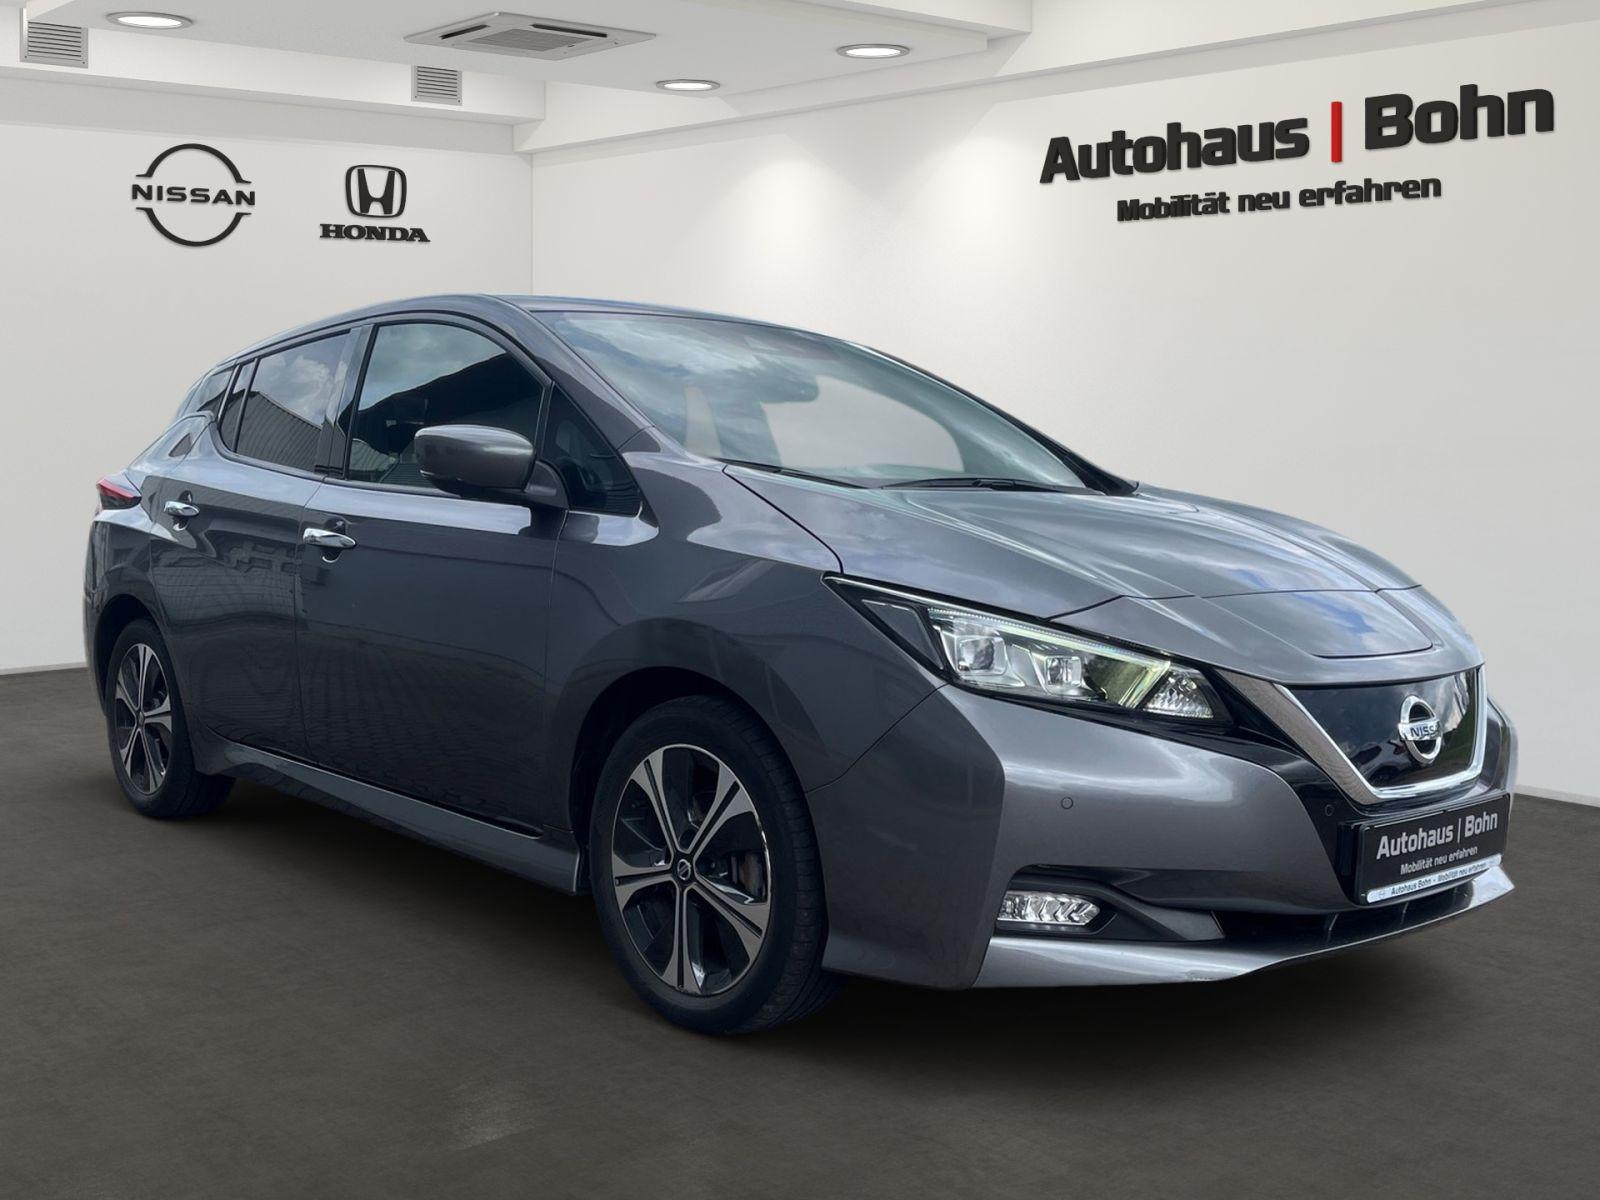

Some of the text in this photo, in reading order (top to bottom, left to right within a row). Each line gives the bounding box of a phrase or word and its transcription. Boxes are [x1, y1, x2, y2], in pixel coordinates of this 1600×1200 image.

[1039, 83, 1555, 184] Autohaus Bohn
[131, 183, 256, 206] NISSAN
[1116, 177, 1442, 222] Mobilität neu erfahren
[319, 223, 431, 243] HONDA
[1409, 721, 1441, 737] NISS
[1376, 811, 1498, 860] Autohaus Bohn
[1400, 846, 1478, 875] Mobilität neu erfahren
[1390, 881, 1418, 895] Autohaus
[1418, 877, 1432, 889] Bohn
